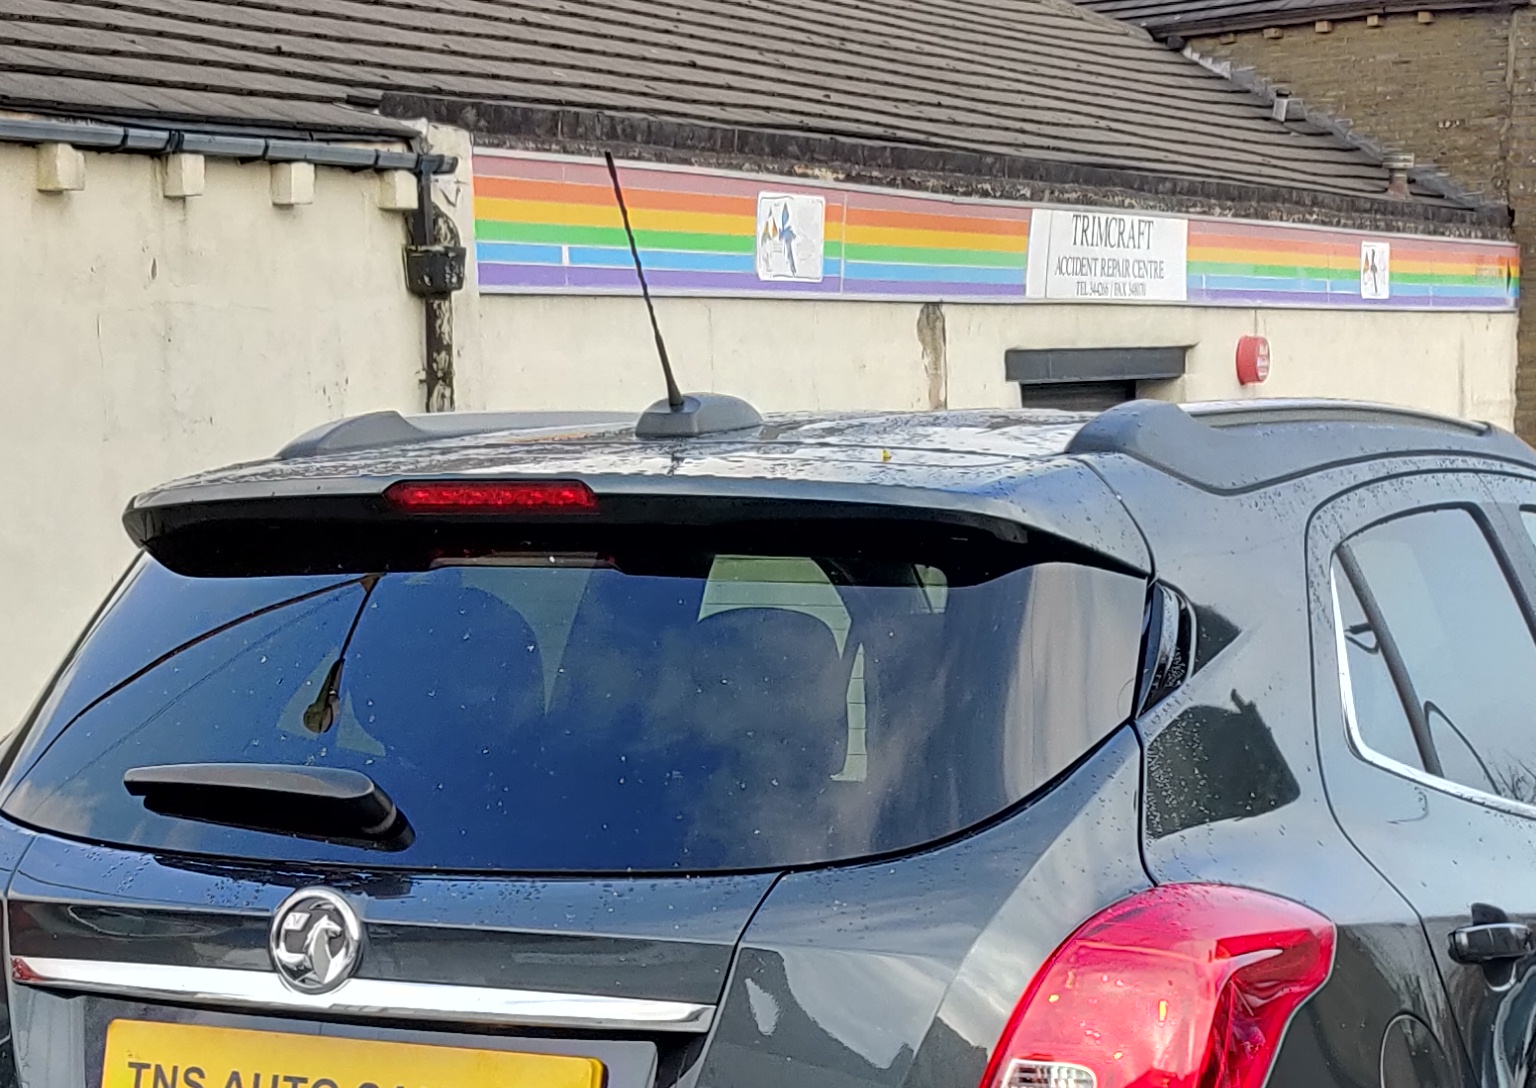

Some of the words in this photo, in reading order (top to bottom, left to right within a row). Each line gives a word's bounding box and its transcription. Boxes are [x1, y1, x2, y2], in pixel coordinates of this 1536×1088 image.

[1072, 214, 1154, 250] TRIMCRAFT
[1055, 255, 1099, 277] ACCIDENT
[1100, 258, 1130, 278] REPAIR
[1132, 259, 1165, 279] CENTRE
